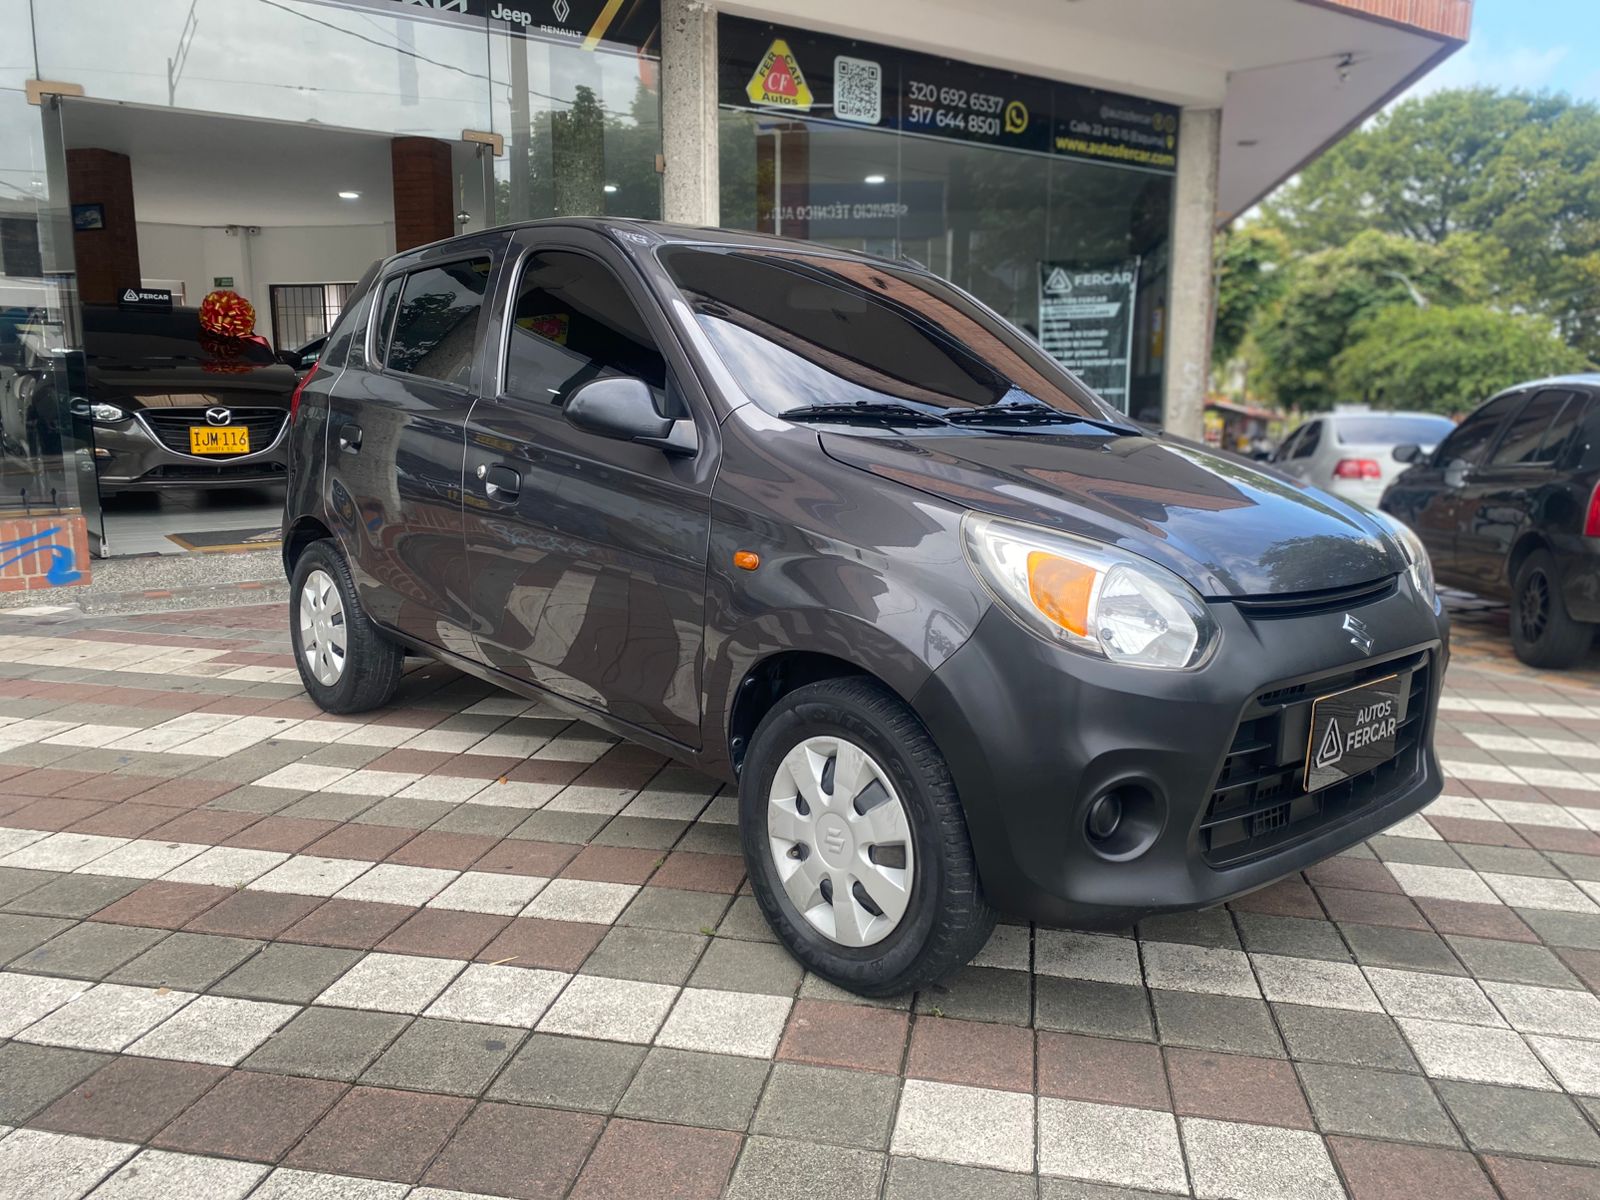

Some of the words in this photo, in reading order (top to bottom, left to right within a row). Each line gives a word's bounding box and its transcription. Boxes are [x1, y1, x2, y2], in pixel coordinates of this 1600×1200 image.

[491, 3, 532, 26] Jeep
[540, 24, 582, 38] RENAULT
[759, 51, 776, 78] FER
[785, 54, 803, 86] CAR
[767, 72, 790, 92] CF
[761, 93, 799, 105] Autos
[908, 81, 937, 102] 320
[940, 87, 967, 108] 692
[970, 92, 1004, 113] 6537
[908, 104, 934, 125] 317
[936, 109, 966, 130] 644
[968, 115, 1001, 136] 8501
[1074, 272, 1133, 287] FERCAR
[194, 432, 218, 446] IJM
[223, 432, 246, 446] 116
[1356, 700, 1391, 726] AUTOS
[1346, 717, 1396, 752] FERCAR
